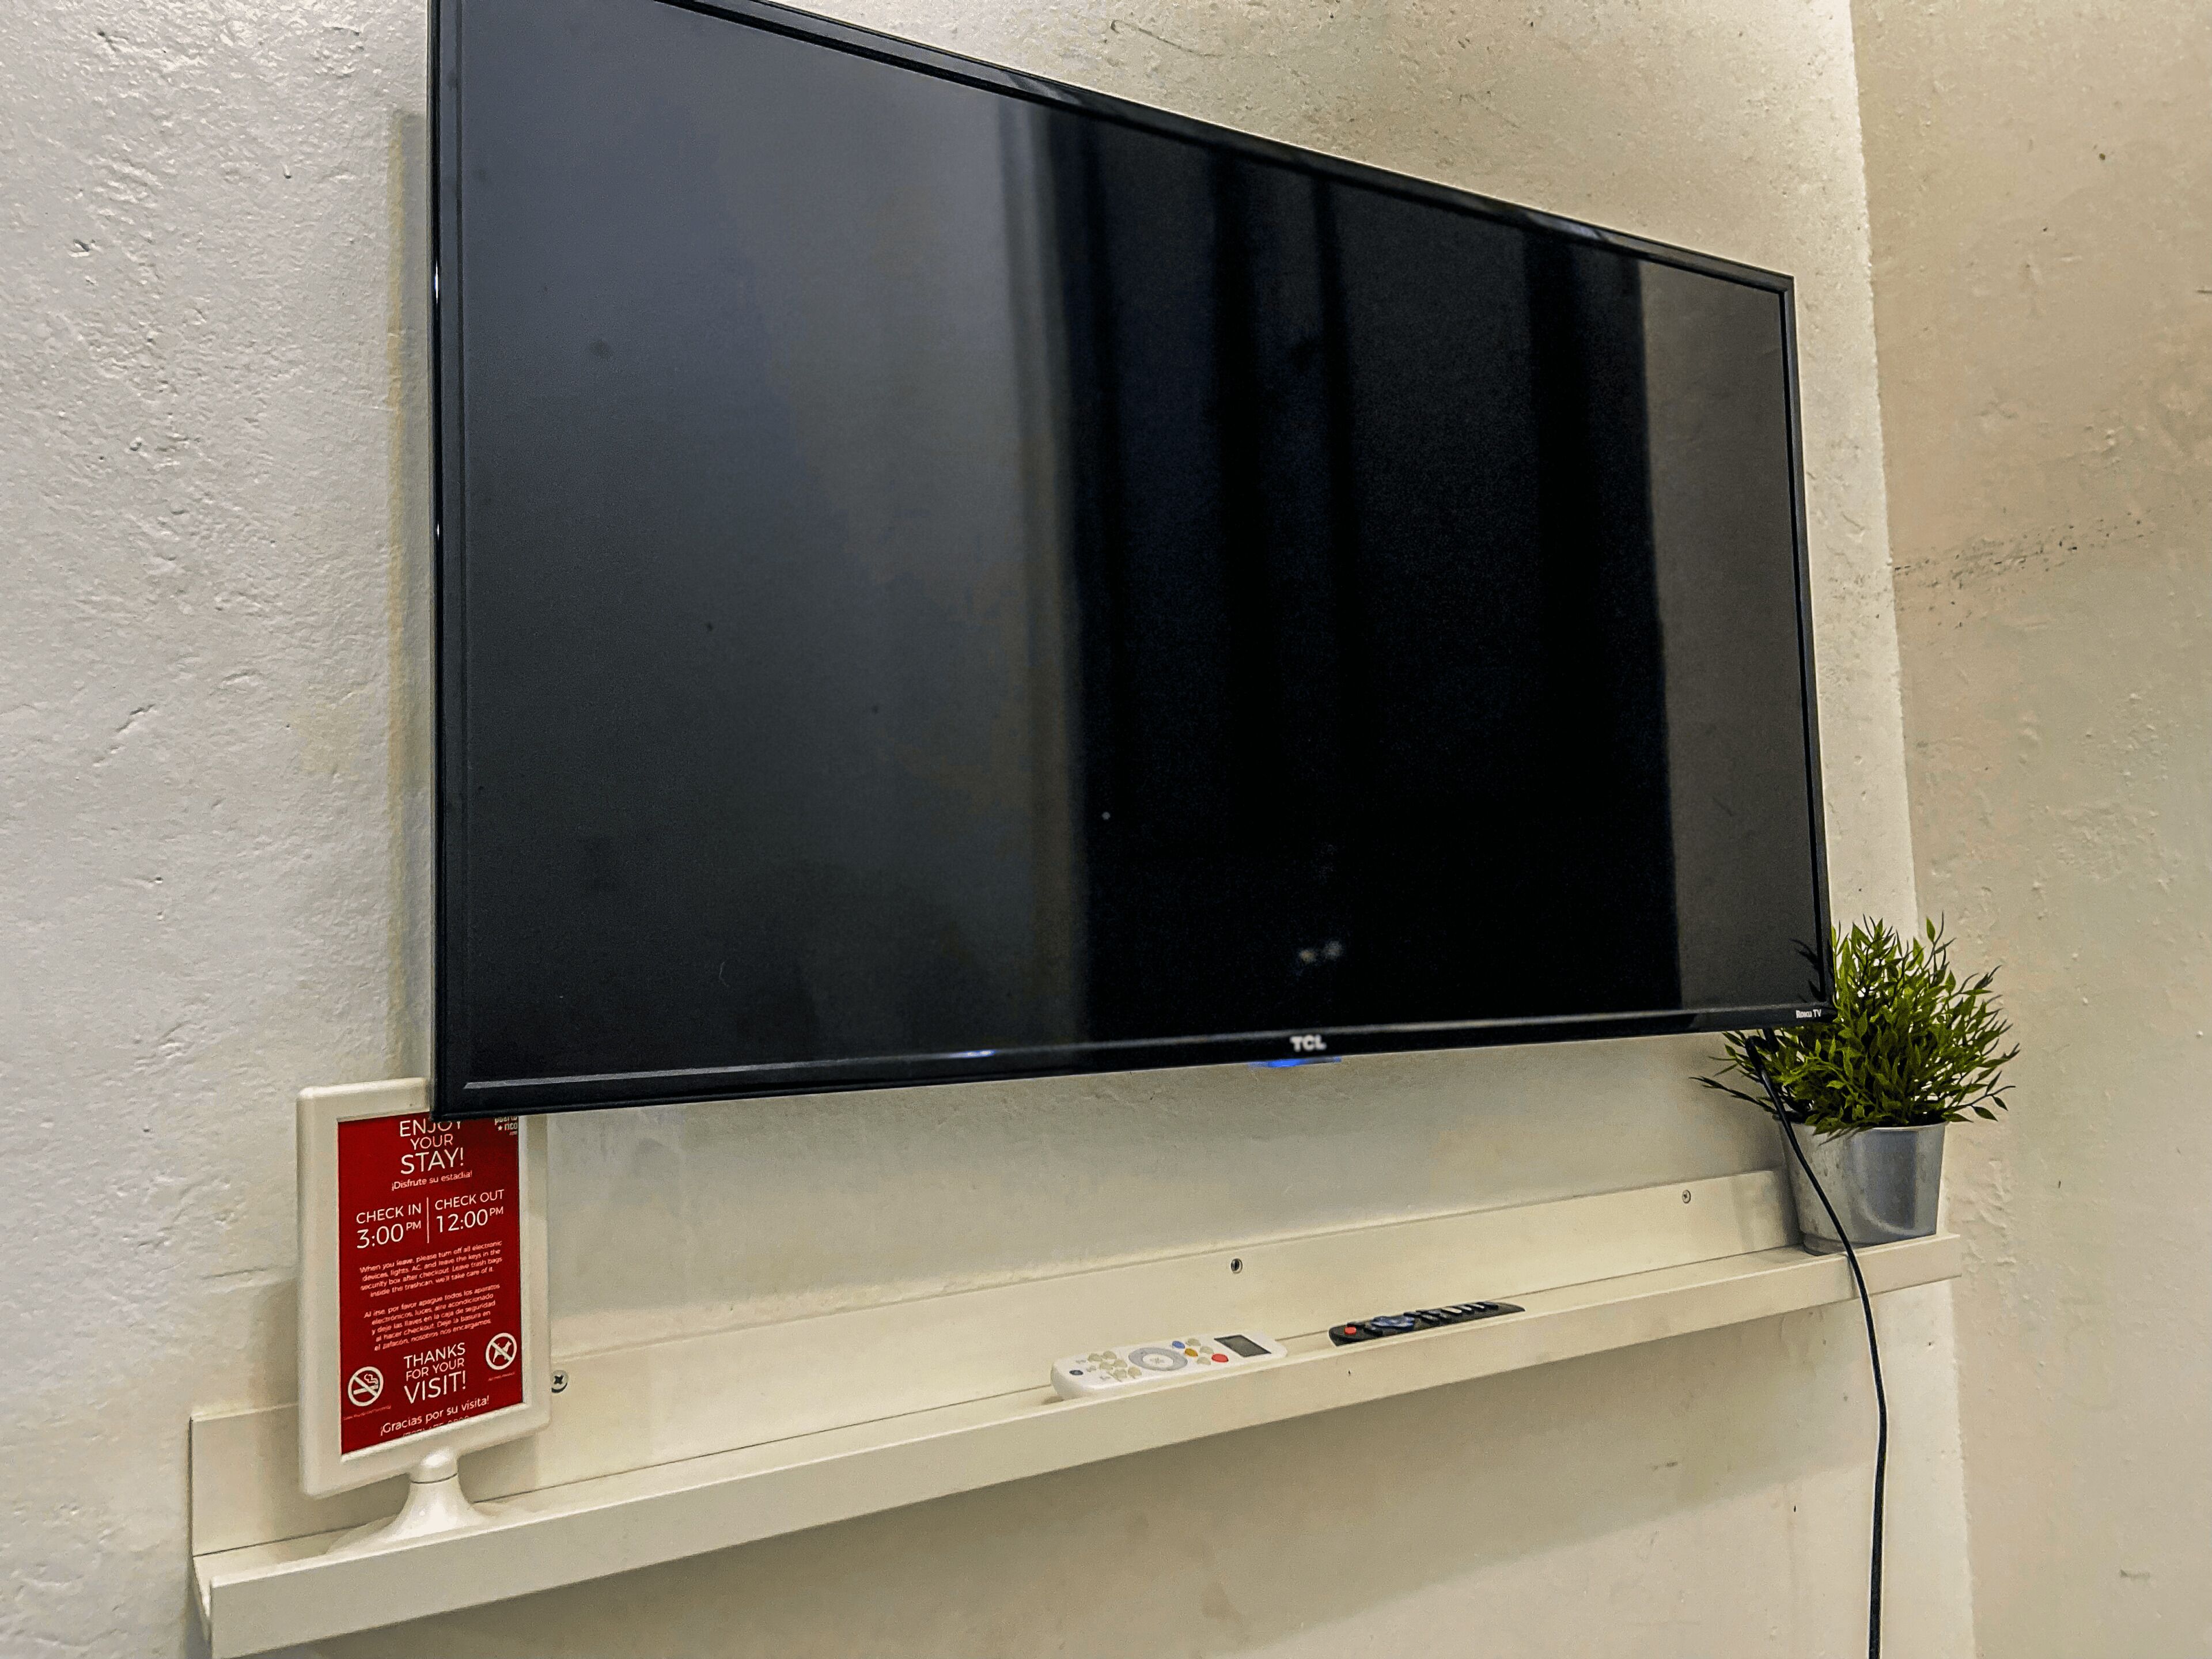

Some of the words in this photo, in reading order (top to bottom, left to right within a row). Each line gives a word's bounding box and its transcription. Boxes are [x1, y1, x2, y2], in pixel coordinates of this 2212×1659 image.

[1796, 1010, 1812, 1018] Roku
[1813, 1009, 1821, 1017] TV
[1290, 1035, 1327, 1052] TCL
[410, 1134, 453, 1150] YOUR
[400, 1147, 464, 1175] STAY!
[391, 1179, 427, 1191] ¡Disfrute
[434, 1194, 477, 1210] CHECK
[480, 1189, 505, 1203] OUT
[356, 1206, 404, 1224] CHECK
[408, 1203, 422, 1215] IN
[436, 1209, 488, 1233] 12:00
[357, 1224, 404, 1249] 3:00
[359, 1265, 381, 1273] When
[382, 1262, 395, 1270] you
[416, 1254, 437, 1263] please
[453, 1246, 463, 1254] off
[472, 1240, 502, 1251] electronic
[424, 1261, 437, 1269] and
[360, 1281, 388, 1290] security
[452, 1264, 469, 1272] Leave
[419, 1296, 443, 1306] apague
[377, 1325, 392, 1333] deje
[404, 1318, 422, 1326] llaves
[461, 1312, 481, 1322] basura
[374, 1343, 380, 1351] el
[404, 1342, 466, 1369] THANKS
[406, 1367, 429, 1381] FOR
[432, 1357, 465, 1374] YOUR
[404, 1370, 467, 1404] VISIT!
[380, 1416, 422, 1436] ¡Gracias
[426, 1410, 444, 1424] por
[446, 1406, 458, 1416] su
[461, 1395, 490, 1411] visita!
